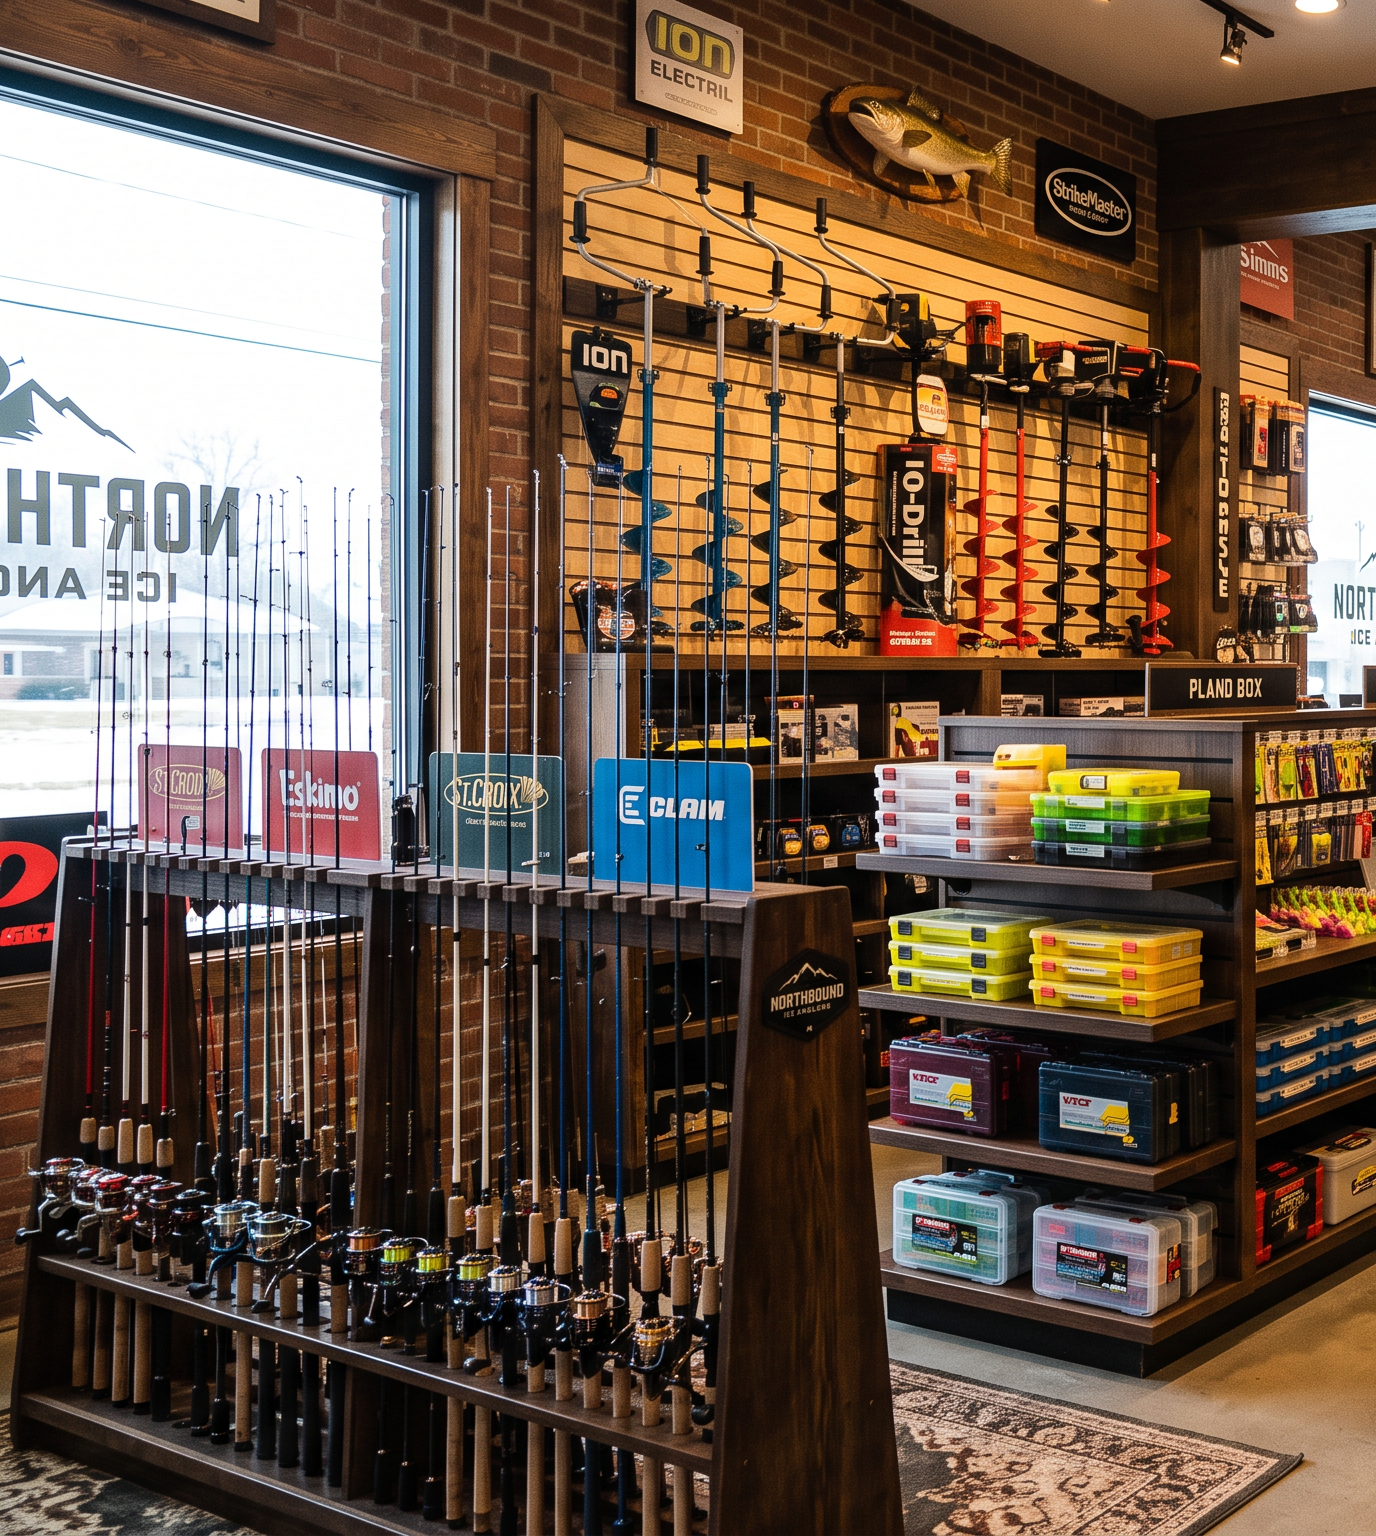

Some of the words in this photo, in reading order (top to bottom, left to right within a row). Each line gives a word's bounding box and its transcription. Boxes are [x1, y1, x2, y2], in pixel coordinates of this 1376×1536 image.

[1241, 244, 1289, 283] Simms
[1189, 678, 1233, 699] PLAND
[1236, 677, 1263, 698] BOX
[279, 769, 359, 812] Eskimo
[649, 796, 726, 821] CLAM
[770, 982, 845, 1013] NORTHBOUND
